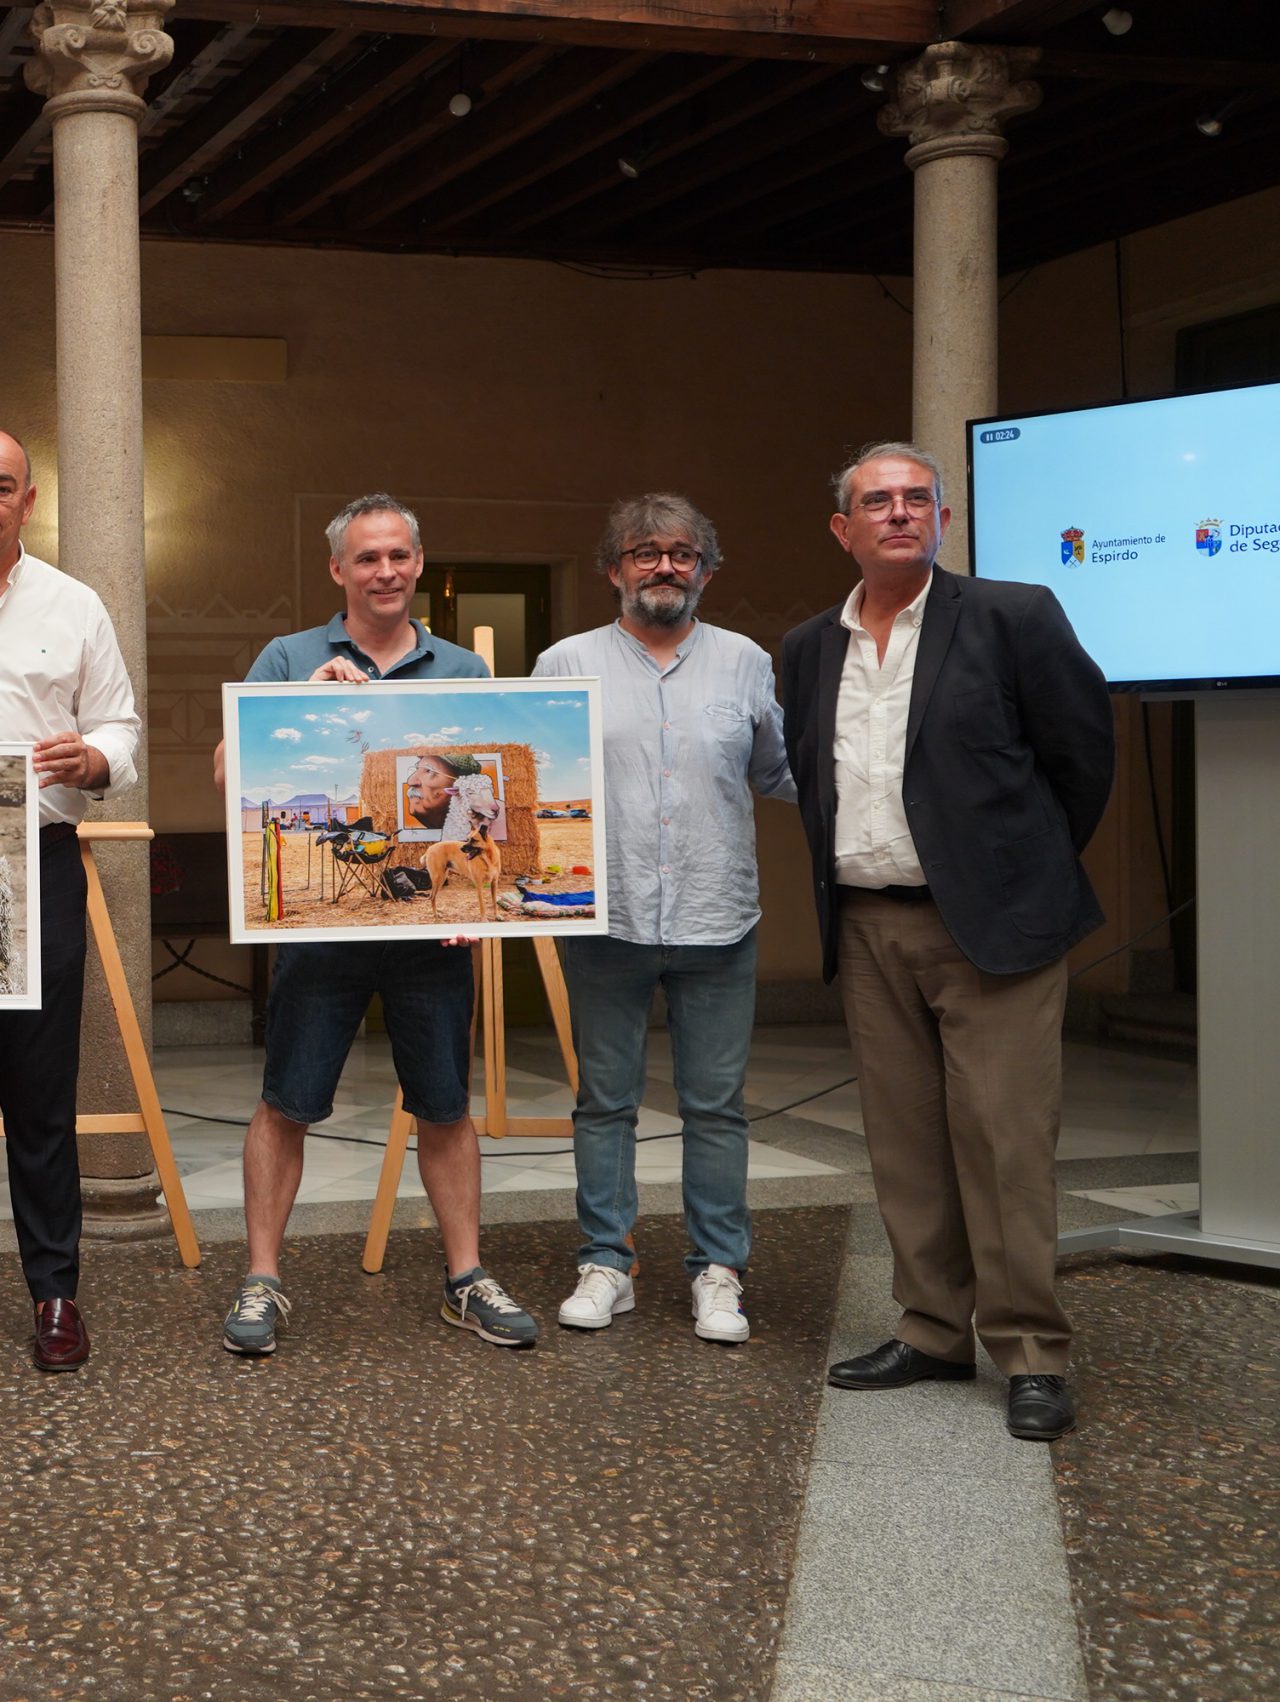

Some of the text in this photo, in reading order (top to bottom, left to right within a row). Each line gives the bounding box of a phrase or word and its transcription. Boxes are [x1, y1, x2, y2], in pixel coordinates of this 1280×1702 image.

[1230, 523, 1280, 539] Diputa
[1091, 533, 1166, 551] Ayuntamiento de
[1230, 538, 1280, 553] de Seg
[1091, 549, 1139, 565] Espirdo
